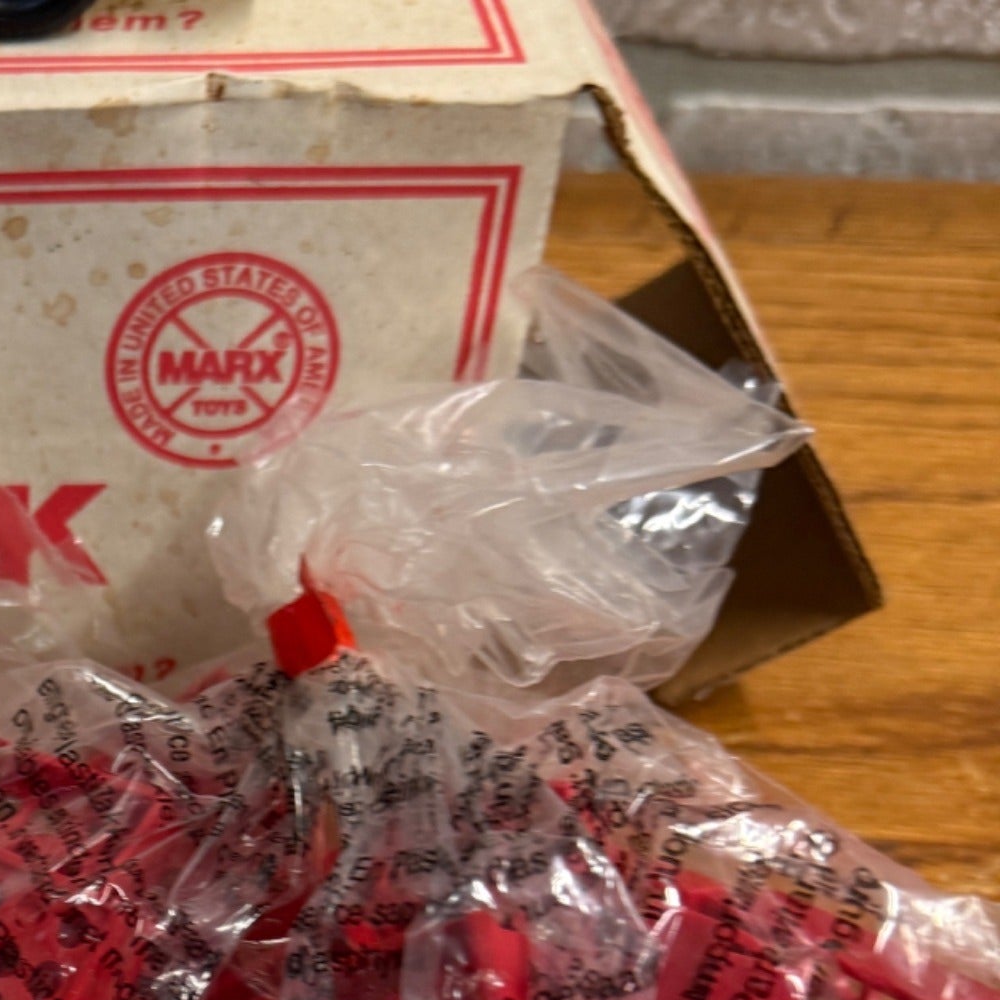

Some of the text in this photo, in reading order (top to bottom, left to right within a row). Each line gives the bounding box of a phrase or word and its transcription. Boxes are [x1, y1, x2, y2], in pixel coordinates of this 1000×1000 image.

[202, 265, 302, 306] STATES
[122, 275, 196, 350] UNITED
[118, 359, 137, 382] IN
[157, 349, 287, 386] MARX
[191, 400, 248, 416] TOYS
